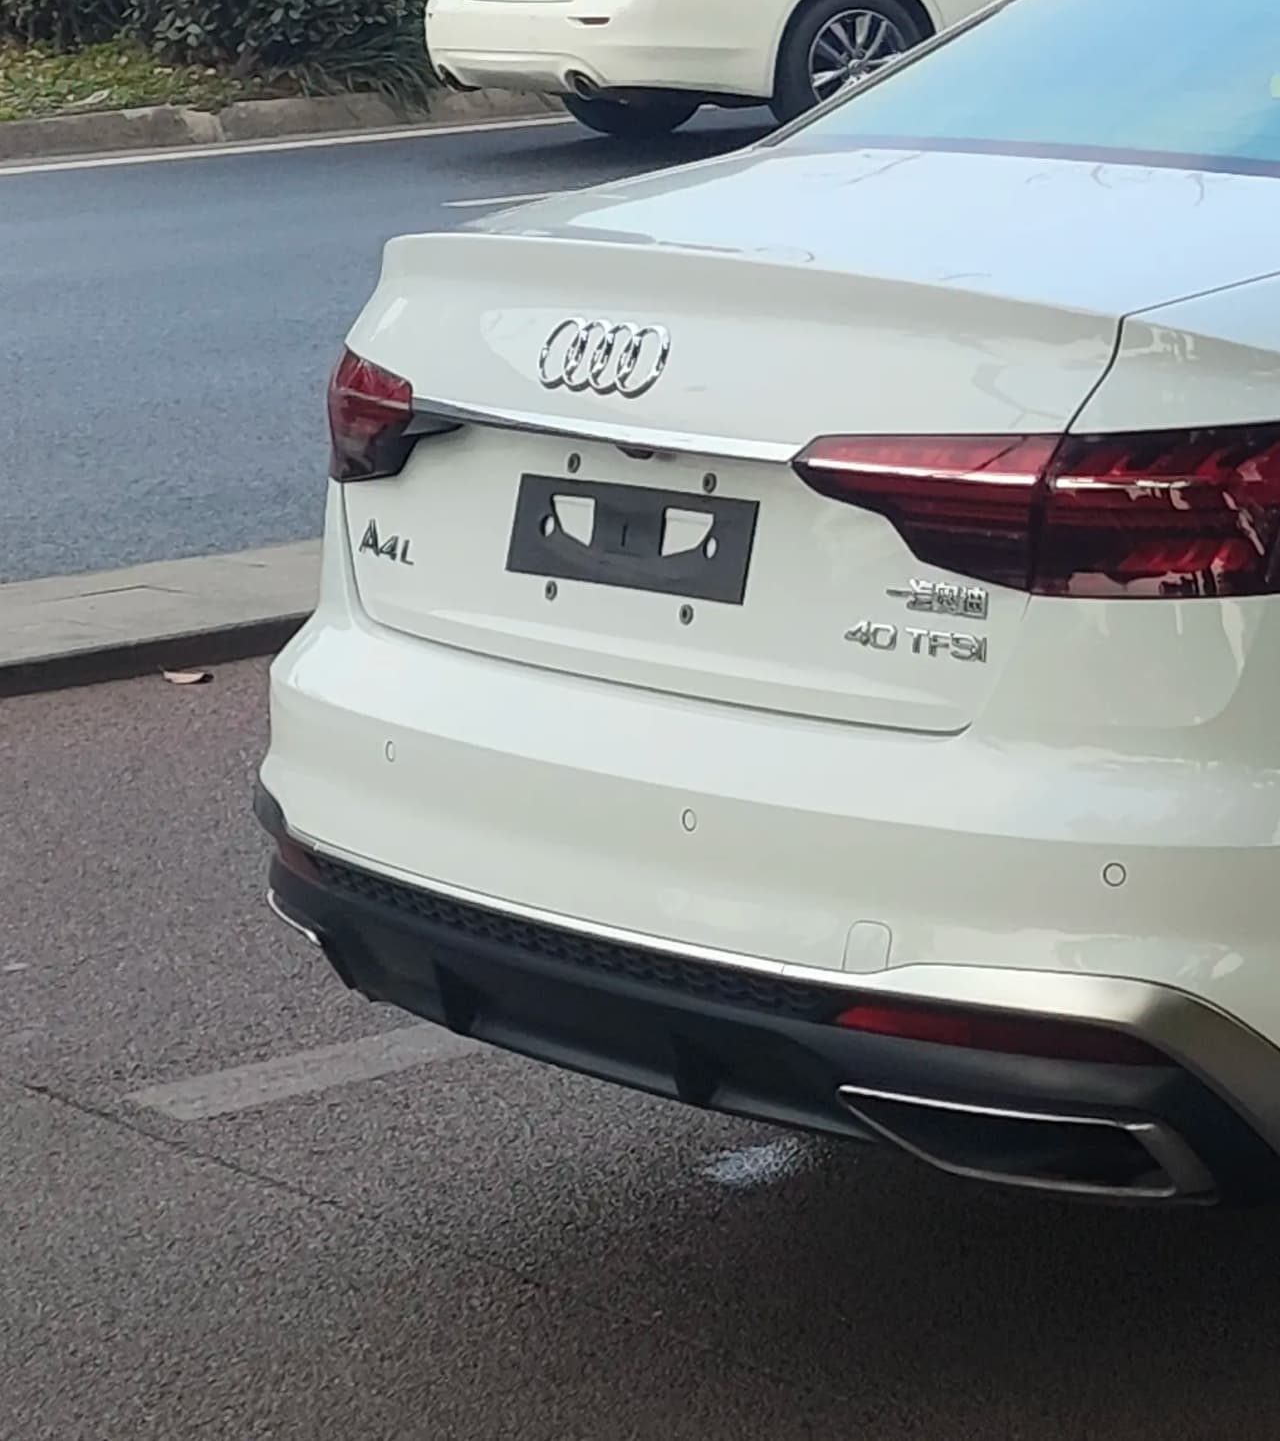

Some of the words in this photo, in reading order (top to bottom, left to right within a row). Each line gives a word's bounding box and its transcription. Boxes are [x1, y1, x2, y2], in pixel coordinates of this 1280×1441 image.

[358, 518, 415, 566] A4L
[885, 578, 989, 620] 一汽奥迪
[843, 621, 898, 651] 40
[904, 627, 988, 663] TFSI
